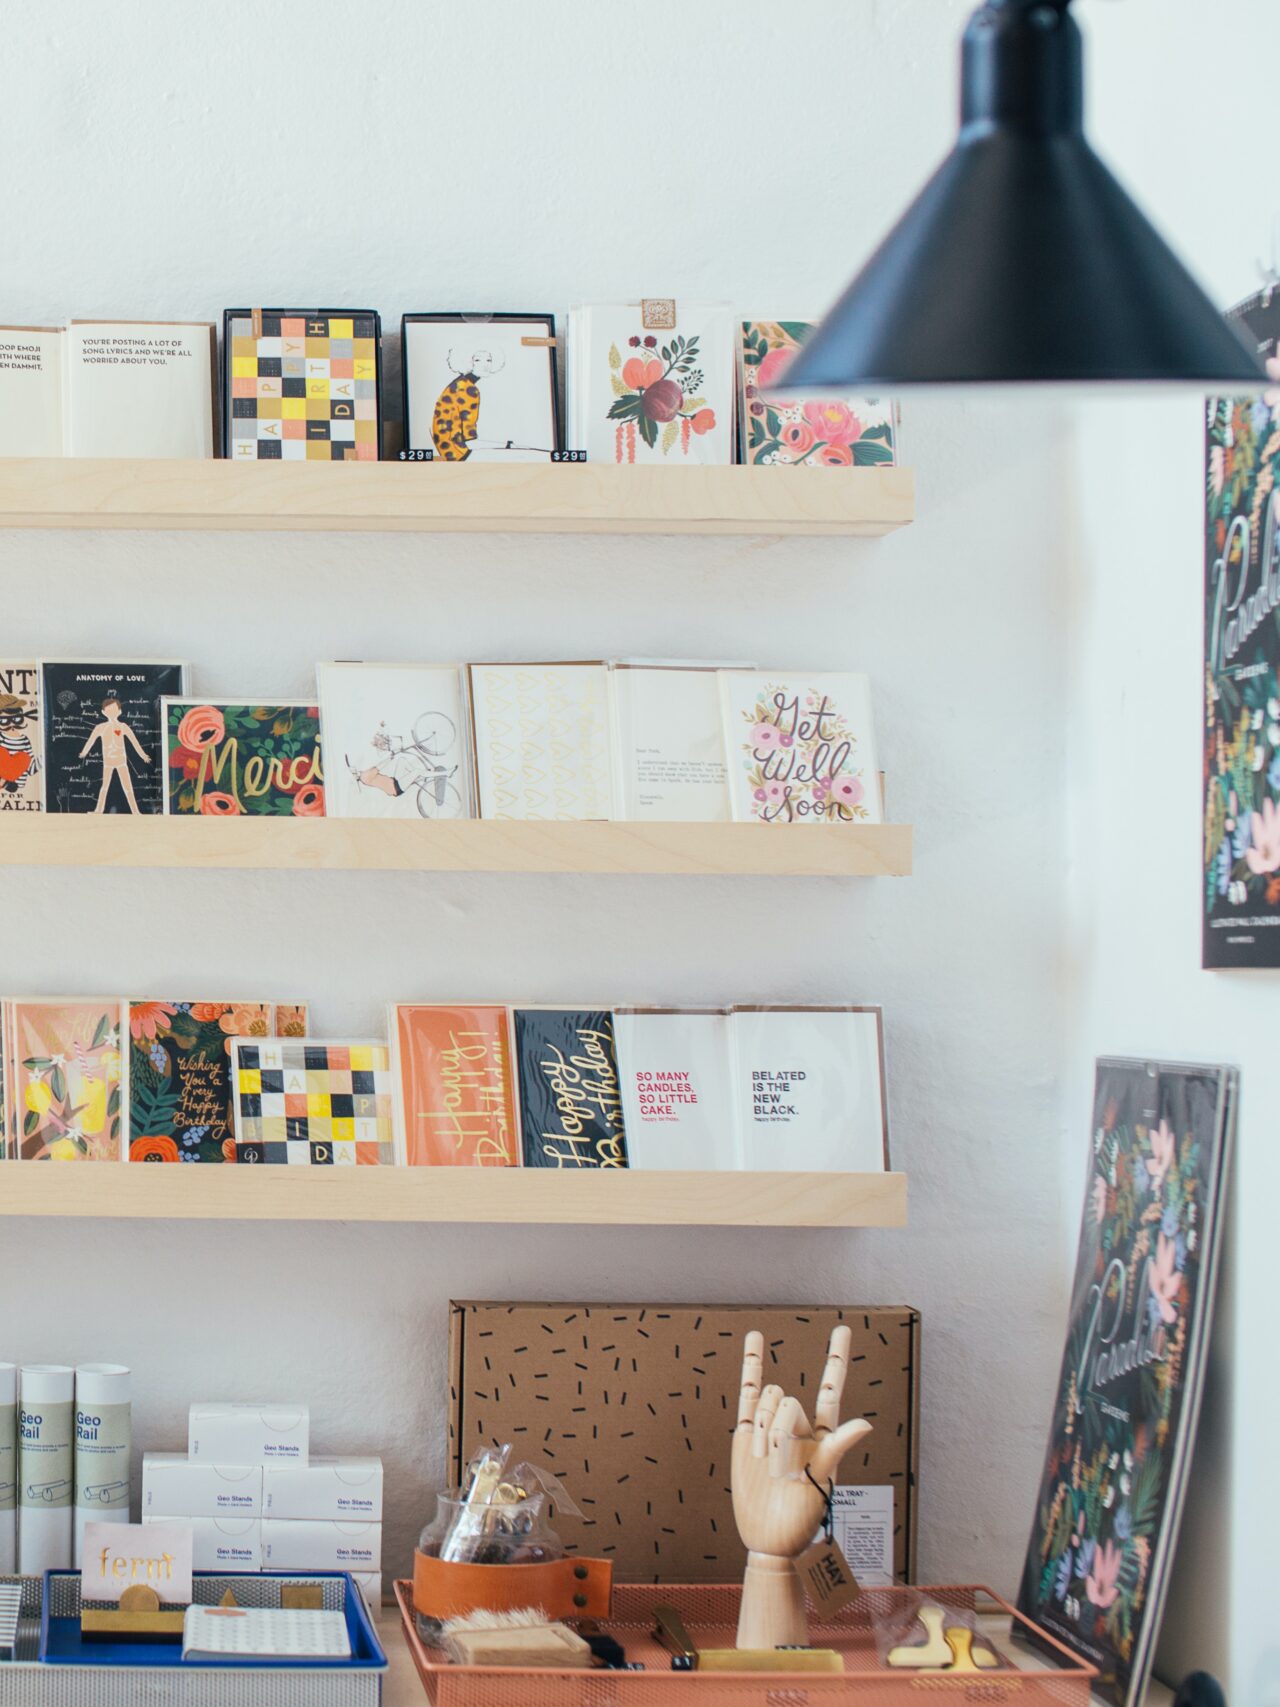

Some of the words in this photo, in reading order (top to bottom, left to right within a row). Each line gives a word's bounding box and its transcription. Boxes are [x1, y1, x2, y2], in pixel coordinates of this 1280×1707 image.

[761, 693, 836, 741] Get
[753, 742, 851, 782] Well
[194, 734, 324, 814] Merci
[759, 786, 853, 823] Soon
[177, 1050, 222, 1079] Wishing
[636, 1072, 652, 1081] SO
[656, 1072, 689, 1081] MANY
[752, 1071, 806, 1081] BELATED
[180, 1073, 206, 1096] You
[418, 1030, 491, 1148] Happy
[638, 1083, 694, 1093] CANDLES,
[753, 1082, 764, 1092] IS
[767, 1083, 790, 1092] THE
[193, 1088, 216, 1101] very
[639, 1094, 655, 1104] SO
[658, 1094, 698, 1104] LITTLE
[754, 1094, 781, 1103] NEW
[178, 1096, 224, 1114] Happy
[540, 1044, 597, 1168] Happy
[640, 1105, 676, 1115] CAKE.
[754, 1105, 799, 1115] BLACK.
[20, 1410, 42, 1424] Geo
[77, 1412, 100, 1426] Geo
[20, 1425, 39, 1439] Rail
[77, 1426, 97, 1440] Rail
[821, 1552, 846, 1586] HAY
